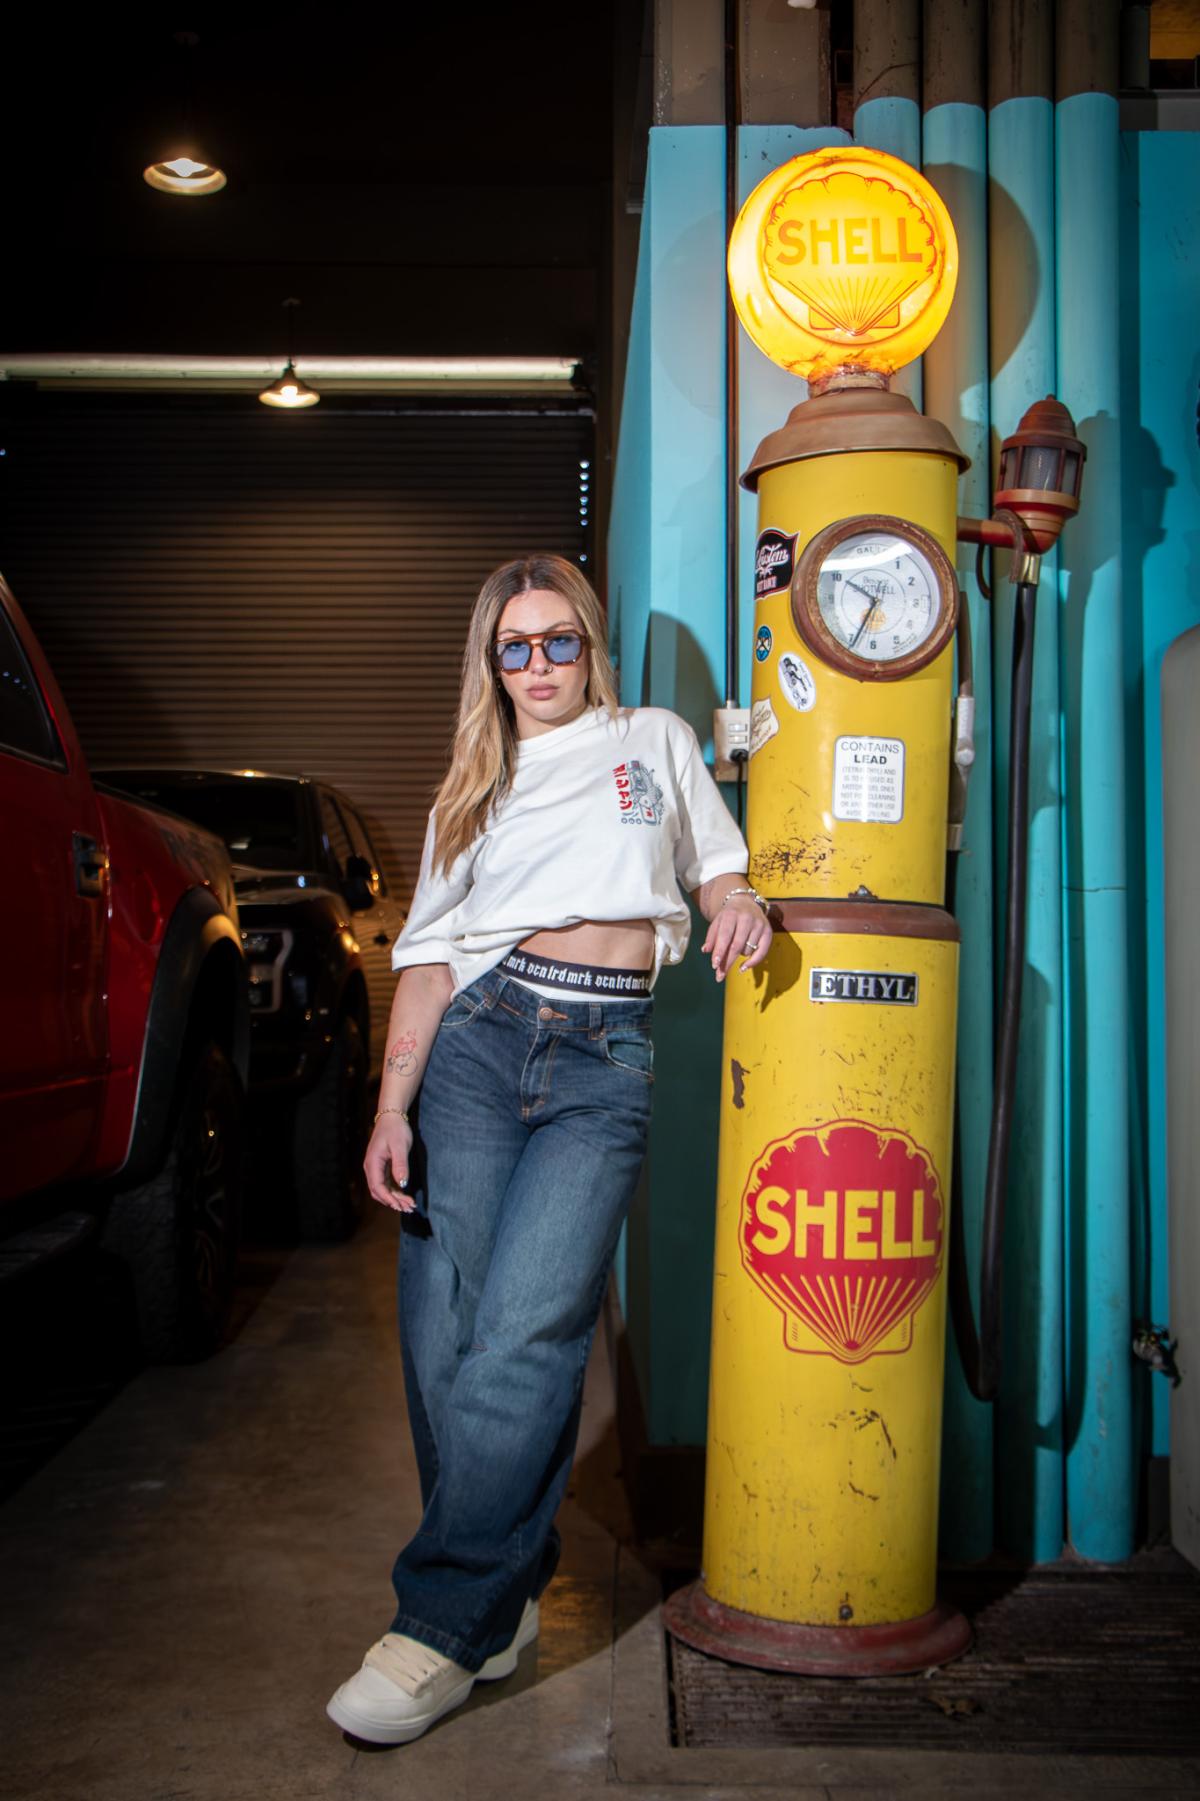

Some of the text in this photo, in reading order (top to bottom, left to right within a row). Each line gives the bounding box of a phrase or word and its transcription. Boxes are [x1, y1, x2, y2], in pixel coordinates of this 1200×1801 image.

[775, 217, 923, 266] SHELL
[831, 570, 842, 581] 10
[907, 576, 916, 587] 2
[869, 640, 877, 650] 6
[841, 741, 900, 753] CONTAINS
[854, 754, 887, 764] LEAD
[819, 974, 911, 999] ETHYL
[751, 1186, 936, 1260] SHELL
